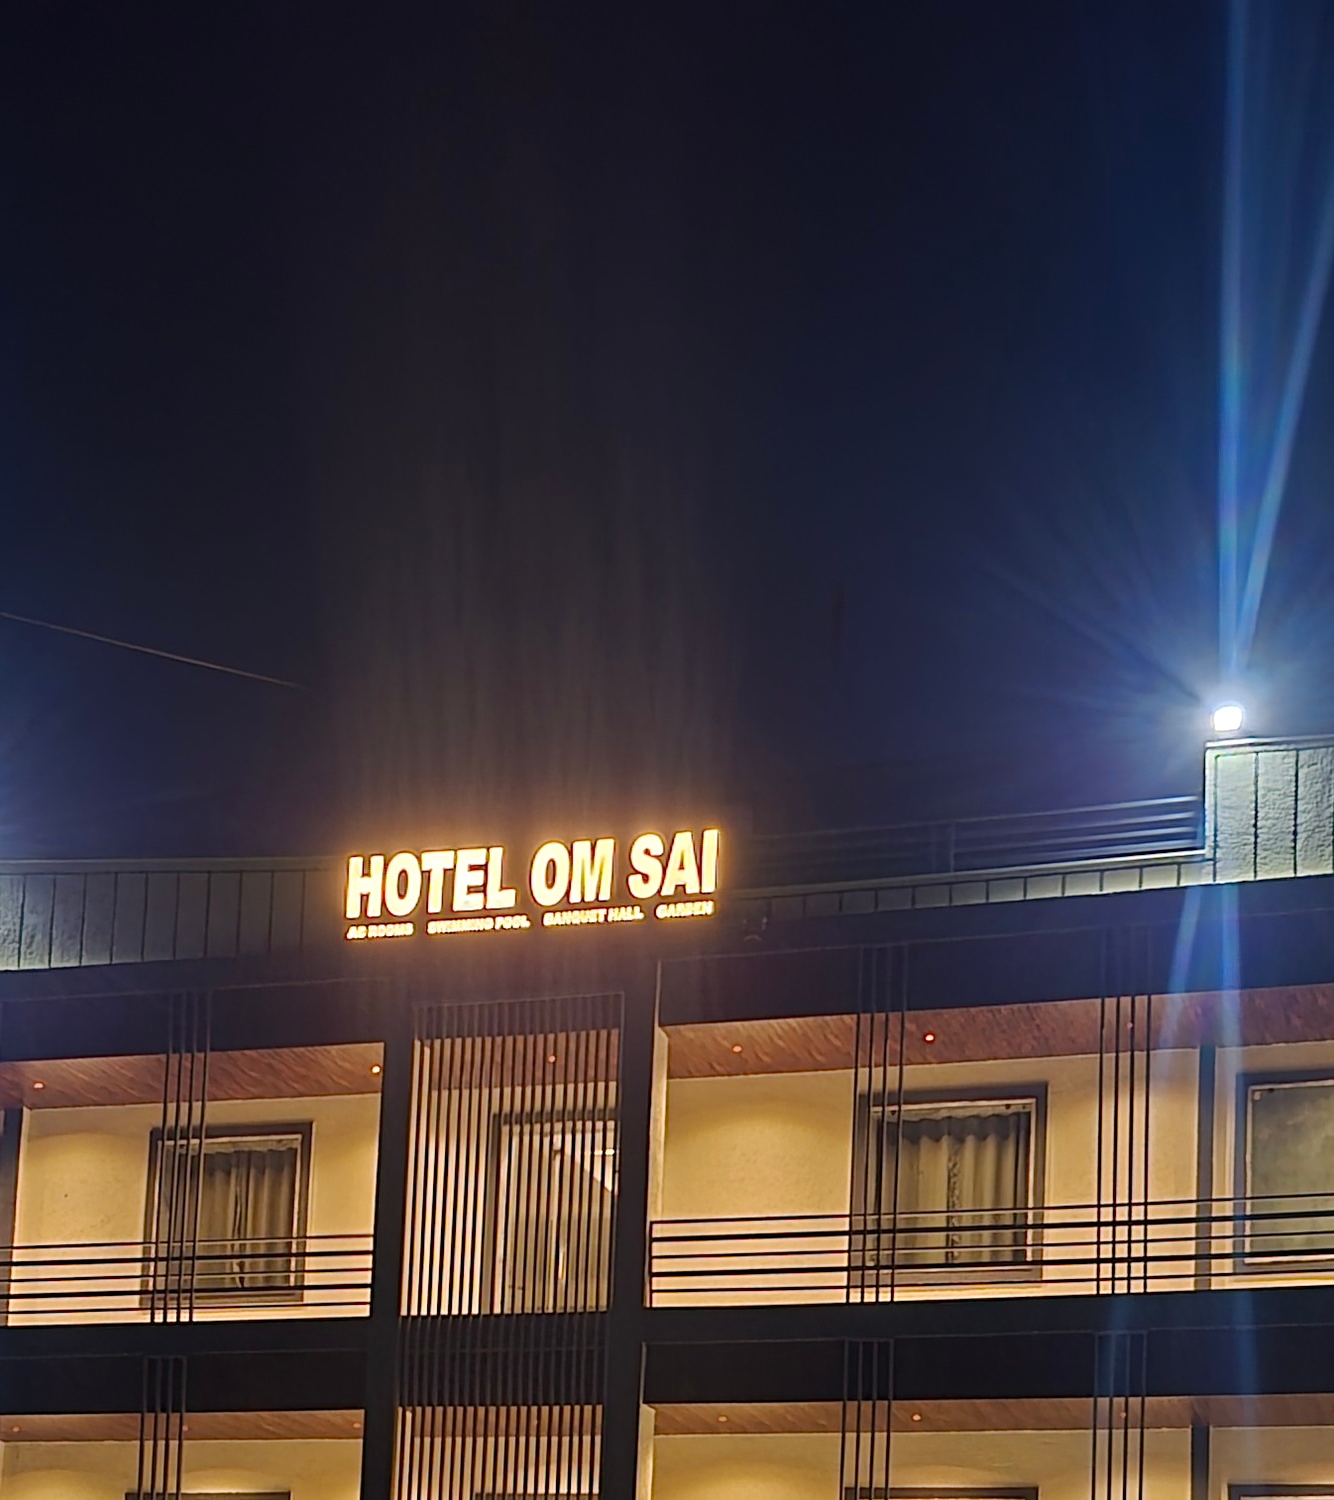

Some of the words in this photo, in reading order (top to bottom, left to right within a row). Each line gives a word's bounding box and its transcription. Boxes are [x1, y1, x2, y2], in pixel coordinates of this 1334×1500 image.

[345, 846, 517, 919] HOTEL
[531, 838, 615, 906] OM
[628, 829, 719, 899] SAI
[494, 915, 531, 930] POOL
[607, 905, 645, 922] HALL
